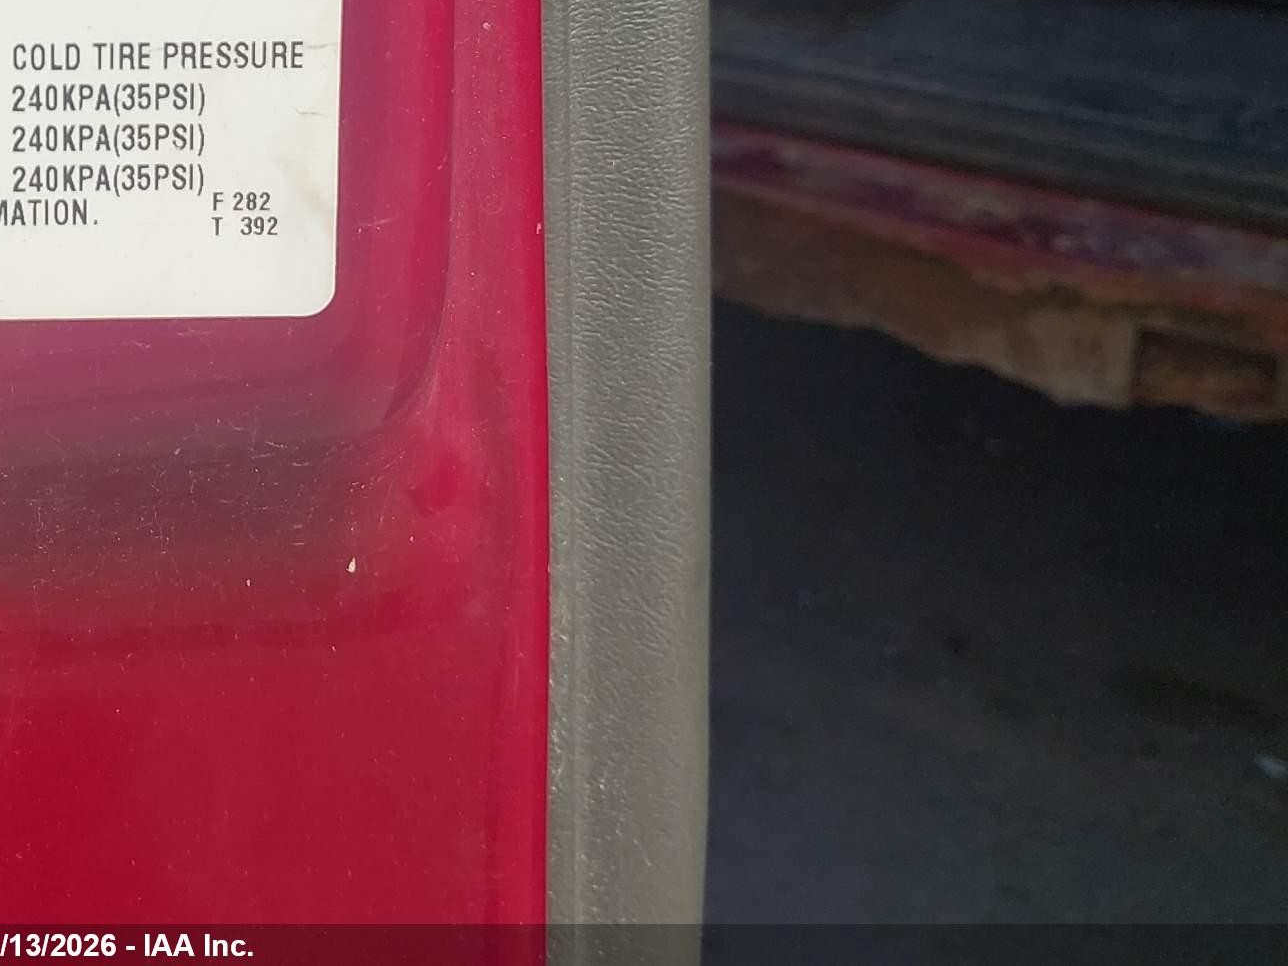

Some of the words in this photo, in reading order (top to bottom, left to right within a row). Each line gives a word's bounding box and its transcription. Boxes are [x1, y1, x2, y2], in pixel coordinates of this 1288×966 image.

[13, 43, 80, 71] COLD
[93, 42, 150, 70] TIRE
[163, 41, 303, 70] PRESSURE
[12, 83, 205, 117] 240KPA(35PSI)
[12, 123, 204, 157] 240KPA(35PSI)
[13, 163, 204, 197] 240KPA(35PSI)
[213, 192, 224, 211] F
[233, 192, 270, 211] 282
[211, 217, 223, 236] T
[240, 216, 277, 235] 392
